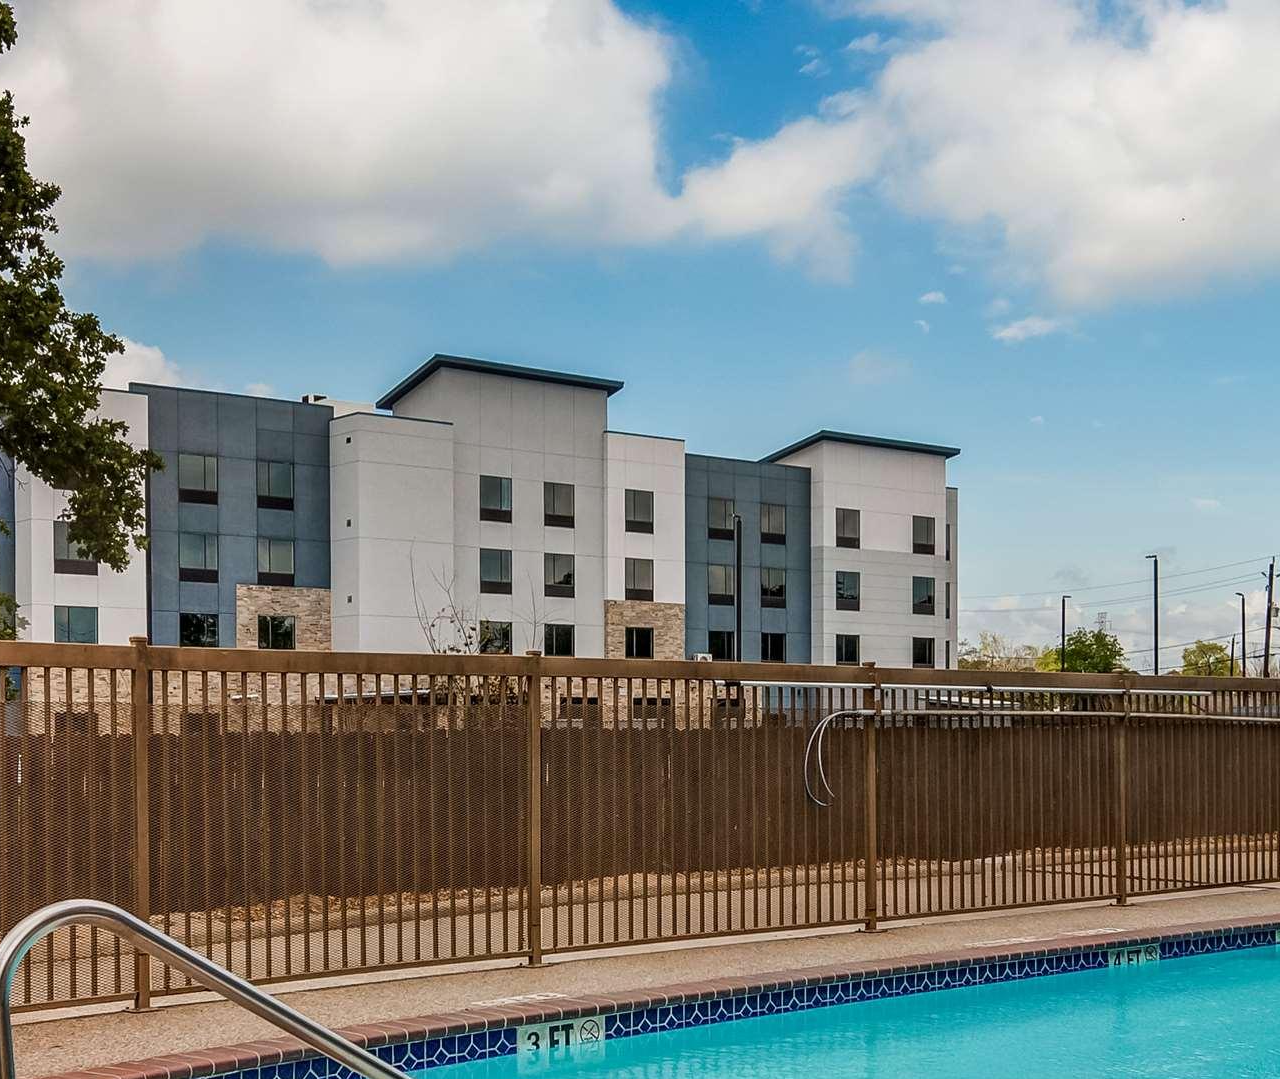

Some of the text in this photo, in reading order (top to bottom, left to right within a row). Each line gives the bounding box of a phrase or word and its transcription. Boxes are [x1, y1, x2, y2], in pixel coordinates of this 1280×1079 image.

[1114, 949, 1142, 965] 4 FT
[527, 1023, 574, 1051] 3 FT
